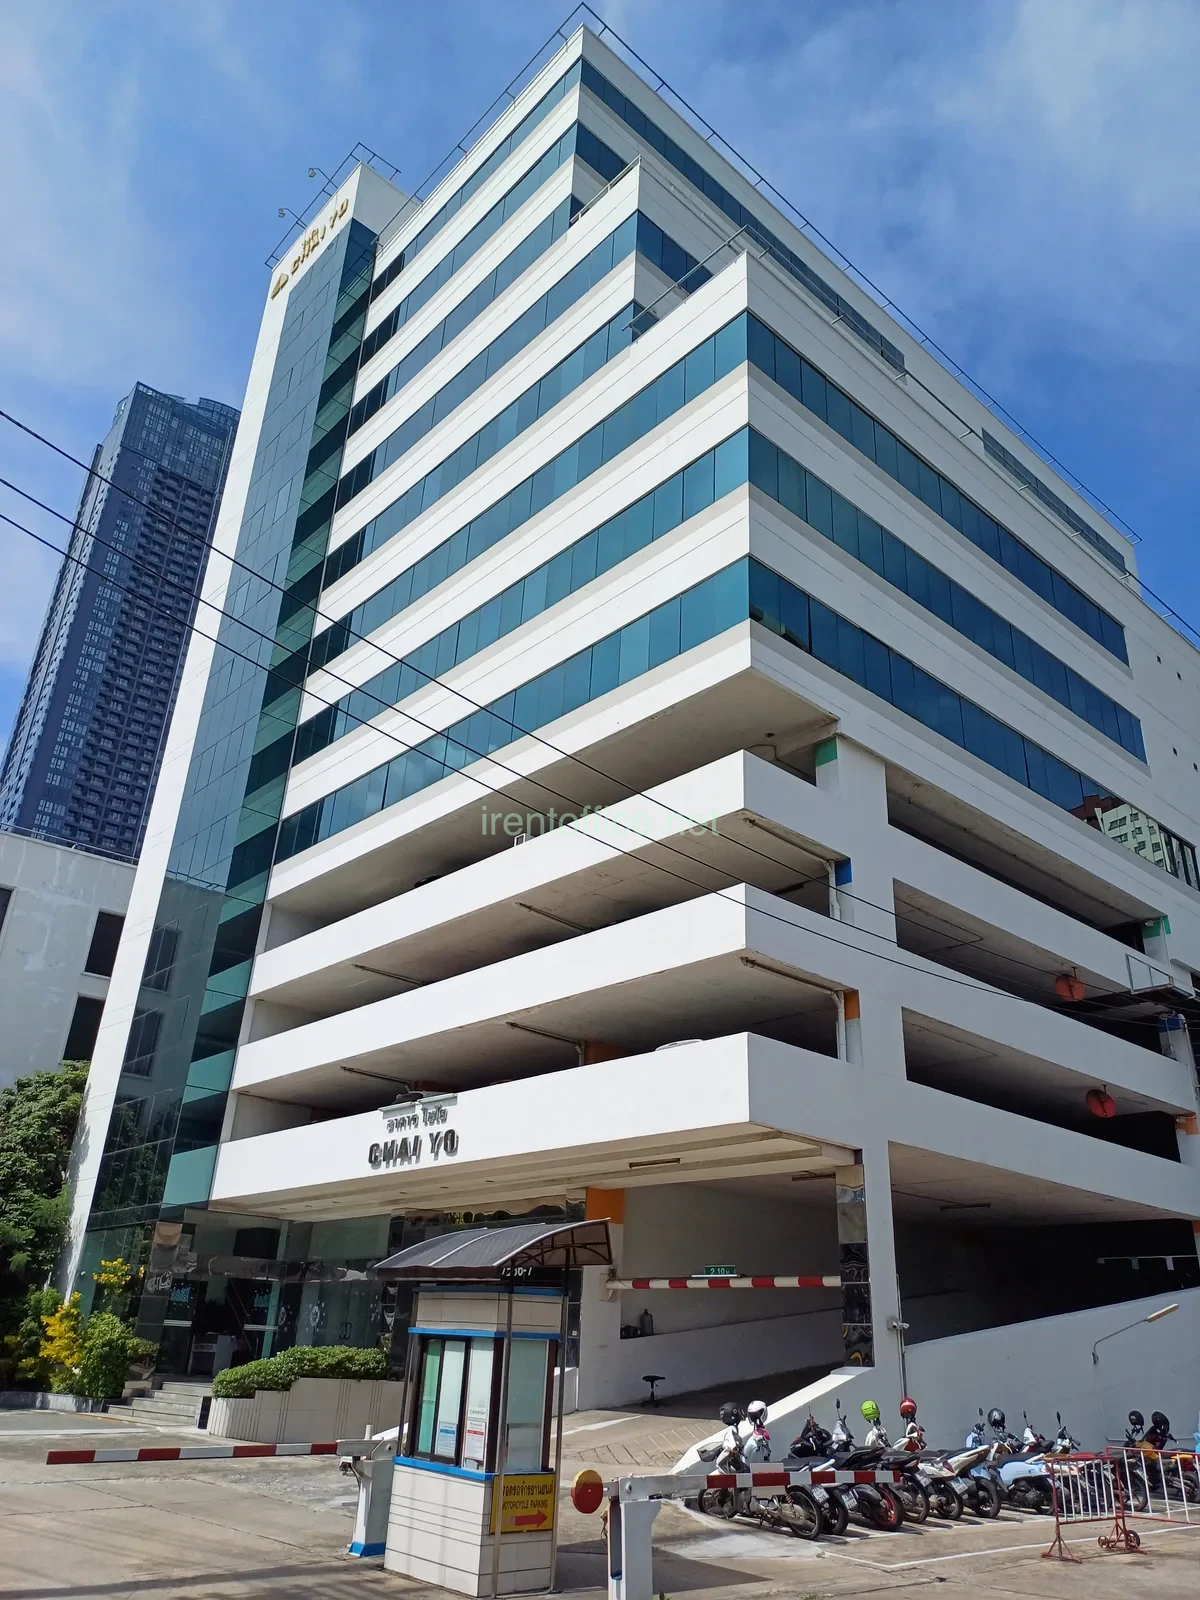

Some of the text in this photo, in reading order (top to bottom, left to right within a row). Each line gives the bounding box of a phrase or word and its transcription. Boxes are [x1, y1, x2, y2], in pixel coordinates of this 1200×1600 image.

[368, 1128, 459, 1167] CHAI YO
[530, 1499, 548, 1509] PARKING
